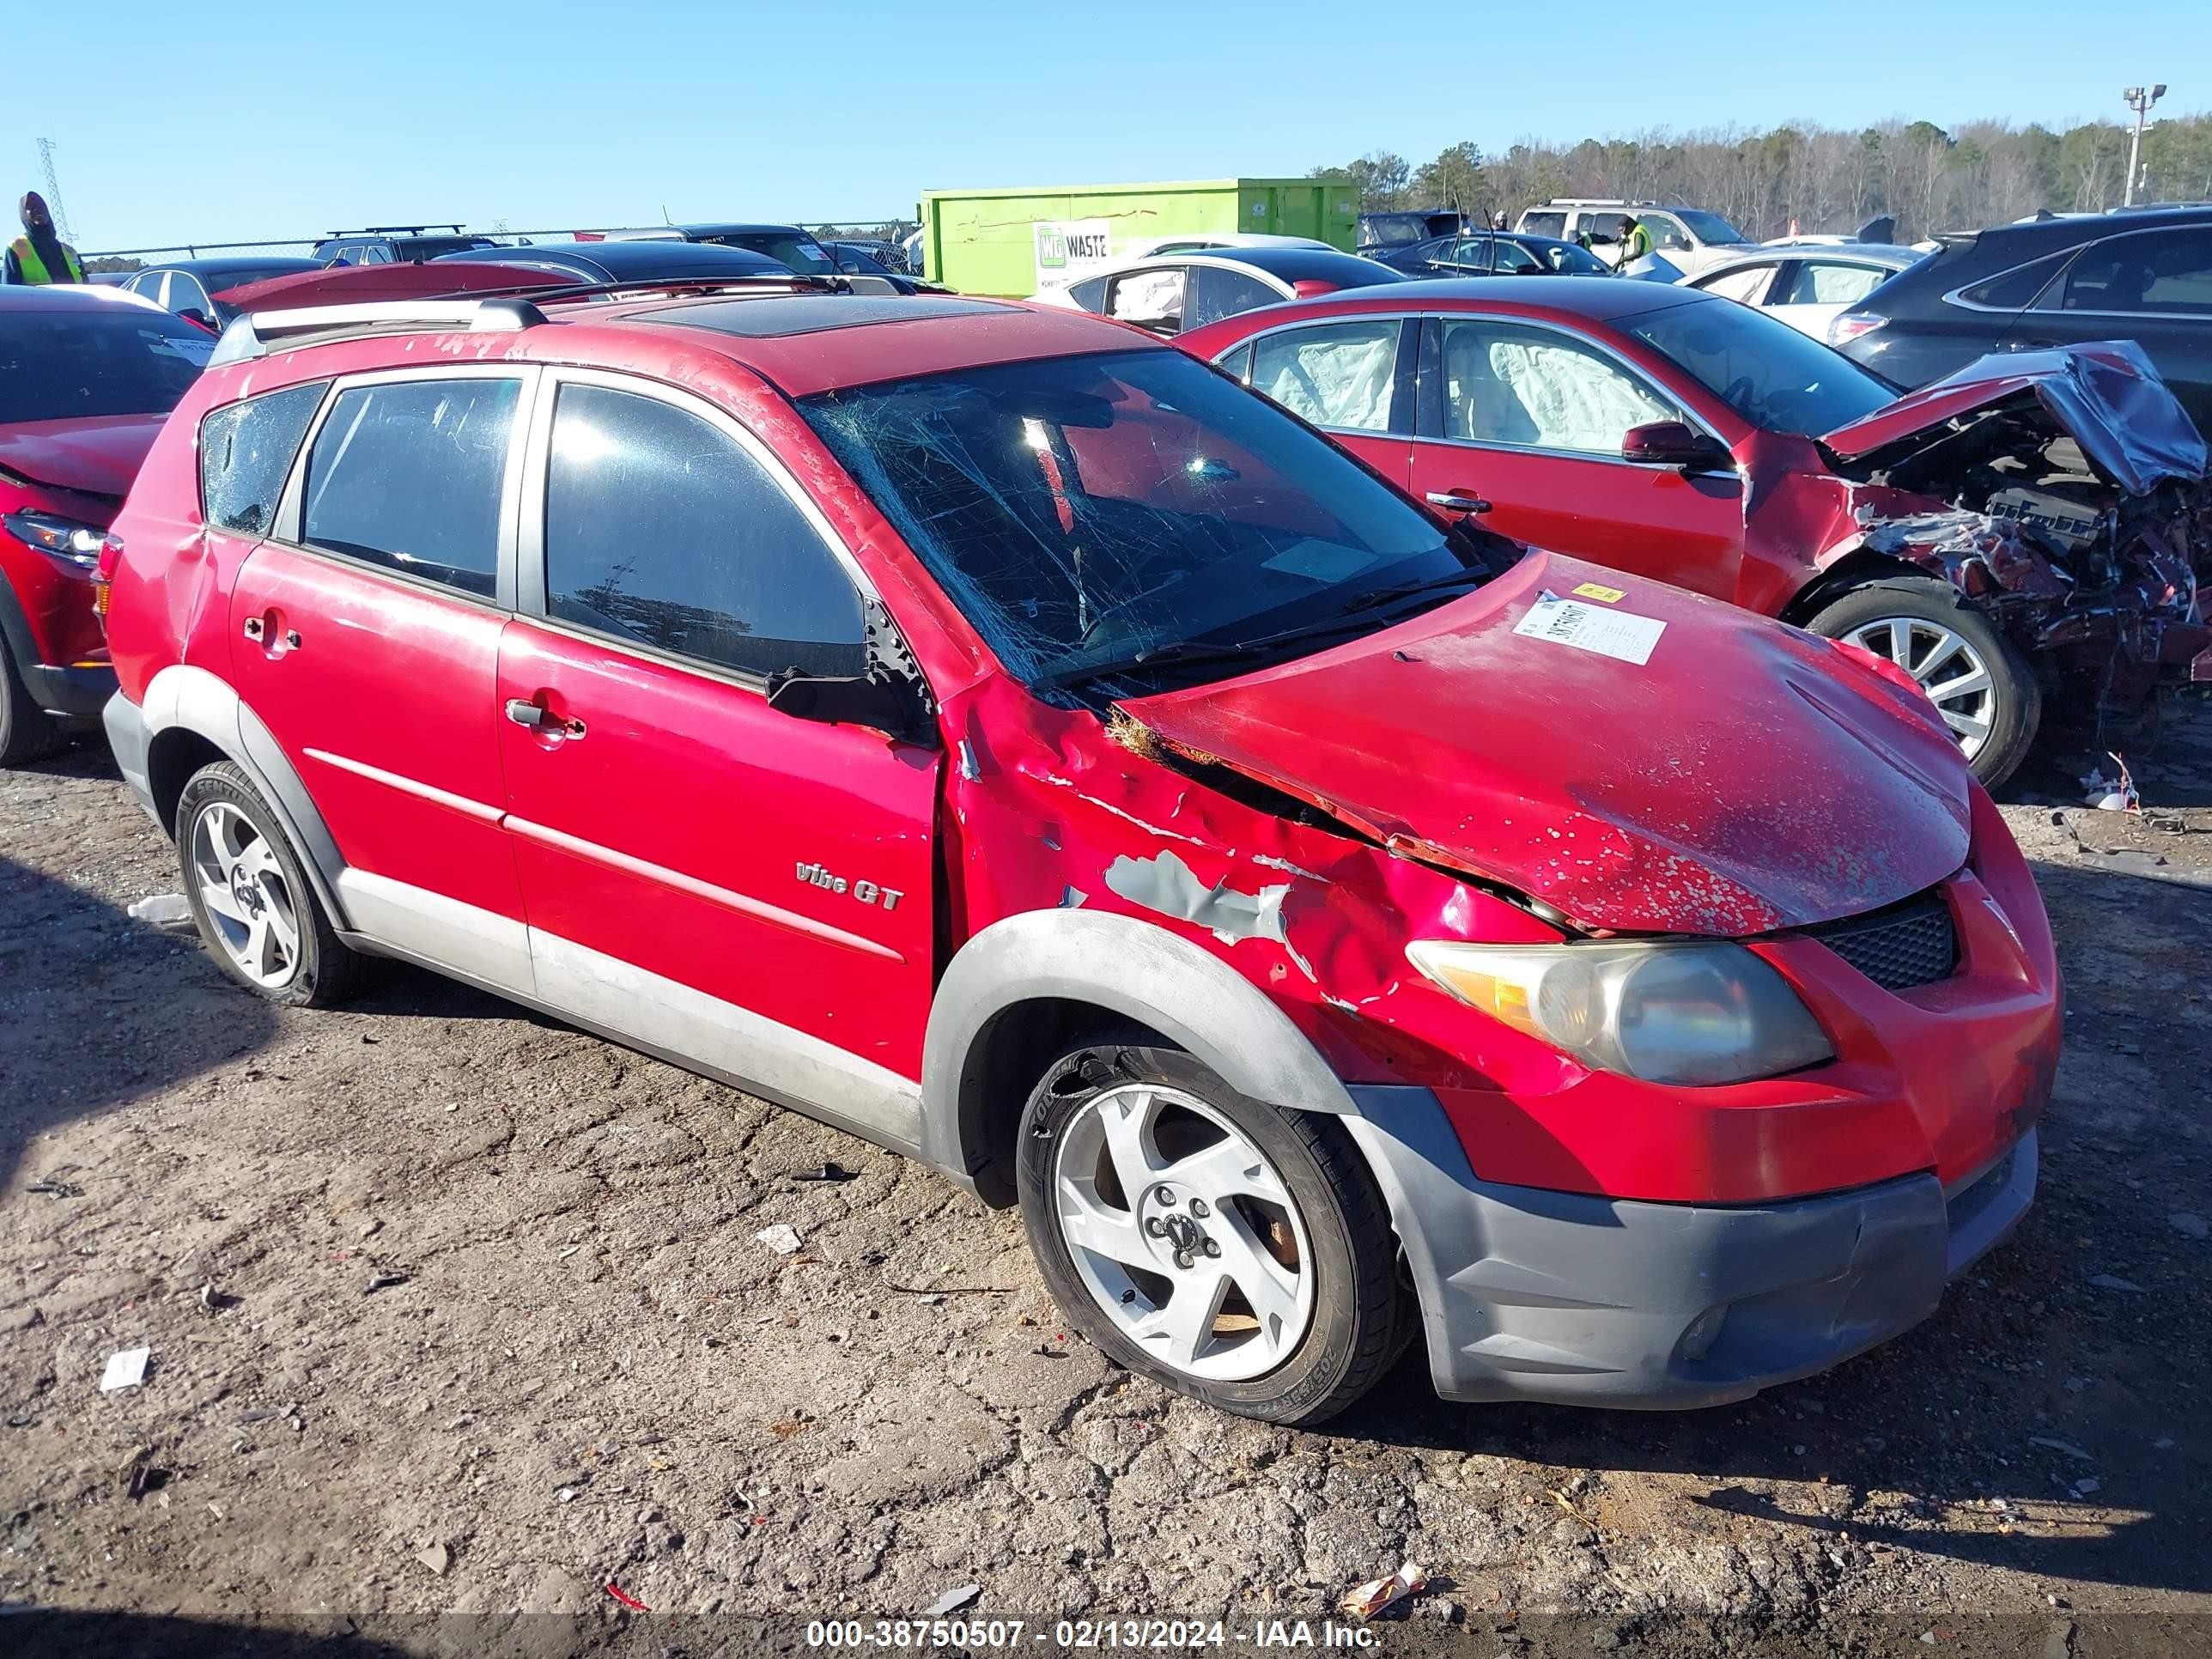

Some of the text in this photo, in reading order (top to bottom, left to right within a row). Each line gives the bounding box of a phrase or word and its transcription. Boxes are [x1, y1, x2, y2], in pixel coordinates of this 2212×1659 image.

[1066, 234, 1107, 258] WASTE
[795, 861, 906, 911] vibe GT
